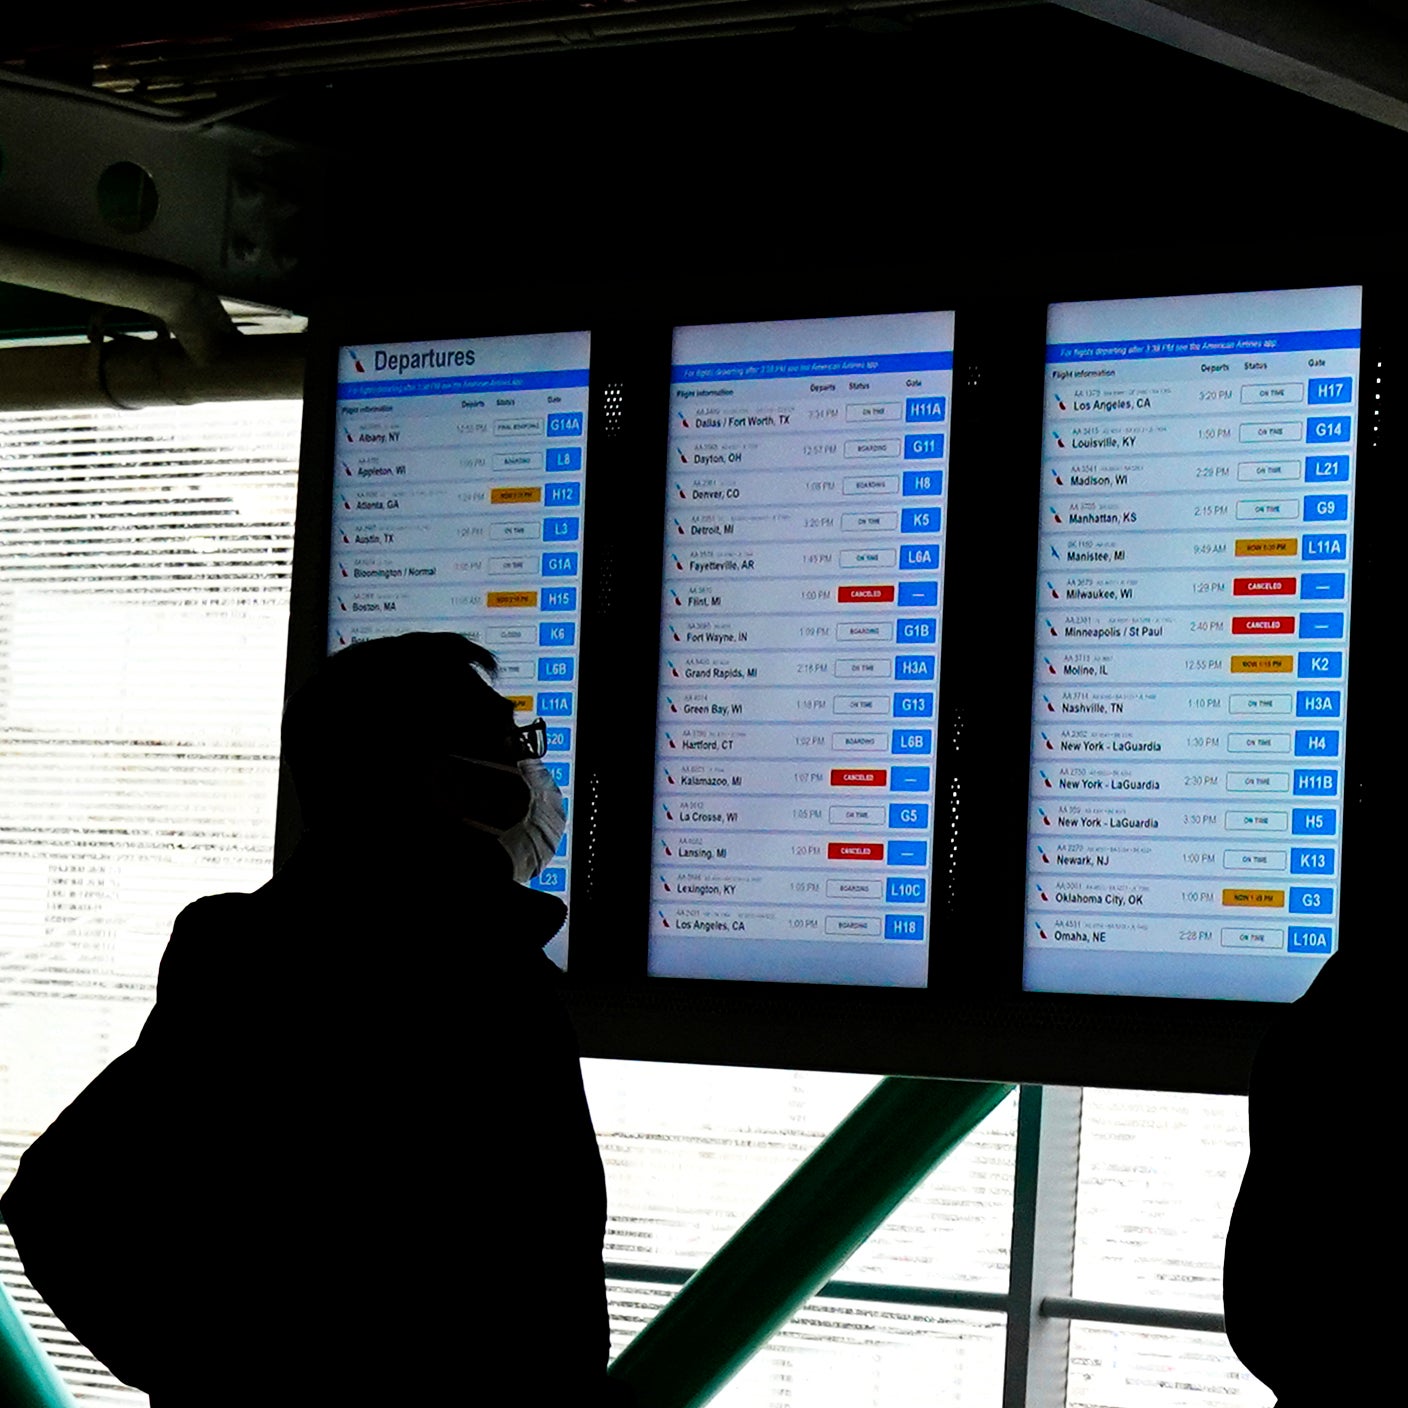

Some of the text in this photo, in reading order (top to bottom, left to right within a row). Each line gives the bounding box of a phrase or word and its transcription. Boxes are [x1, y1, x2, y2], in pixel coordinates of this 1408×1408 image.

[373, 347, 477, 376] Departures
[1319, 384, 1343, 396] H17
[911, 403, 941, 415] H11A
[1074, 398, 1150, 412] Los Angeles, CA
[1316, 423, 1341, 436] G14
[914, 440, 934, 453] G11
[559, 453, 570, 465] L8
[1316, 462, 1338, 475] L21
[916, 477, 930, 488] H8
[553, 488, 572, 499] H12
[1317, 501, 1335, 514] G9
[555, 523, 567, 535] L3
[1309, 540, 1340, 554] L11A
[549, 558, 570, 569] G1A
[549, 593, 569, 605] H15
[551, 628, 564, 639] K6
[905, 624, 929, 636] G1B
[903, 661, 927, 673] H3A
[1312, 658, 1328, 671] K2
[903, 698, 925, 711] G13
[1306, 697, 1332, 710] H3A
[1309, 737, 1326, 749] H4
[901, 809, 917, 822] G5
[1306, 815, 1323, 828] H5
[1301, 854, 1325, 867] K13
[1302, 894, 1320, 906] G3
[894, 921, 915, 933] H18
[1294, 933, 1326, 946] L10A
